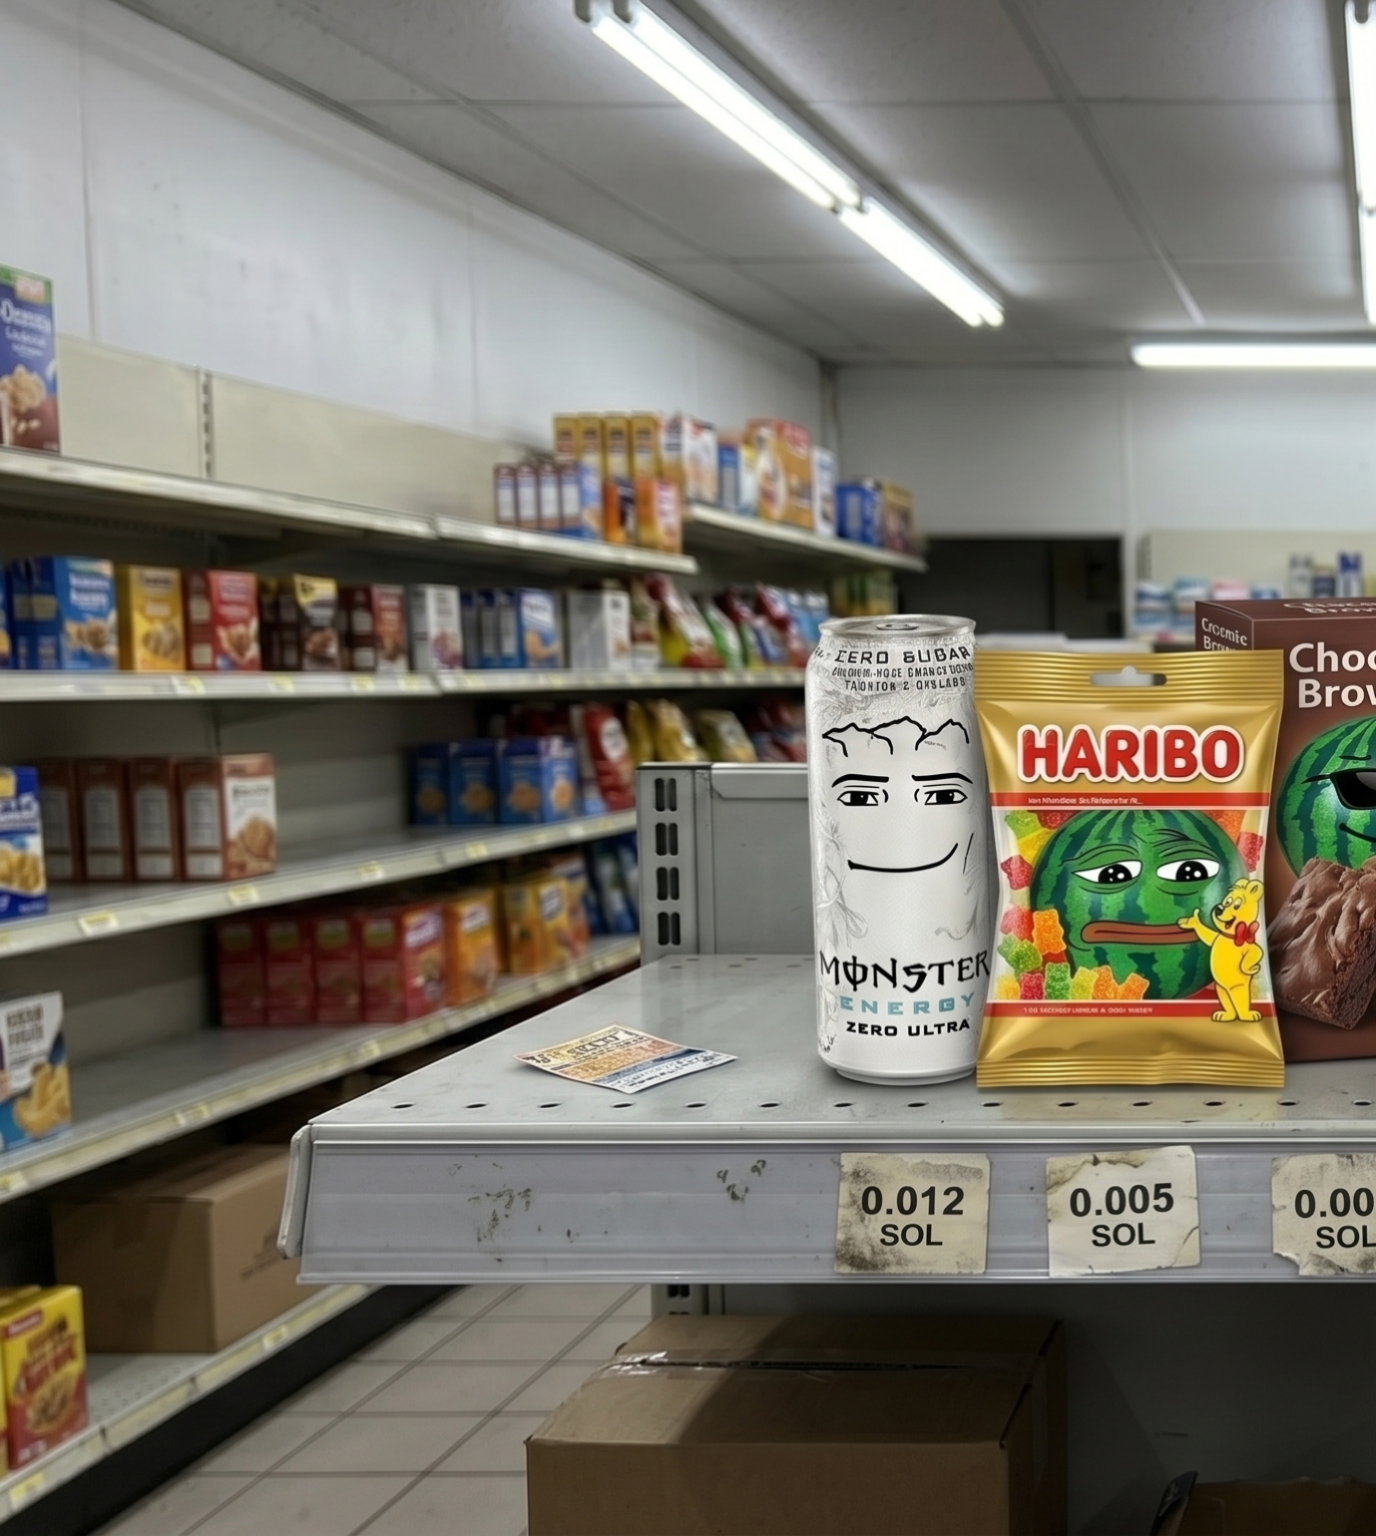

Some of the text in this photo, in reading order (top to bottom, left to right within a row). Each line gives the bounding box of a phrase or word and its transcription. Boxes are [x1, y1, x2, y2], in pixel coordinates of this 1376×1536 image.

[1019, 726, 1242, 781] HARIBO
[819, 949, 990, 993] MONSTER
[839, 992, 975, 1015] ENERGY
[846, 1018, 971, 1037] ZERO ULTRA
[862, 1185, 965, 1216] 0.012
[1070, 1183, 1174, 1217] 0.005
[880, 1223, 943, 1247] SOL
[1092, 1223, 1156, 1247] SOL
